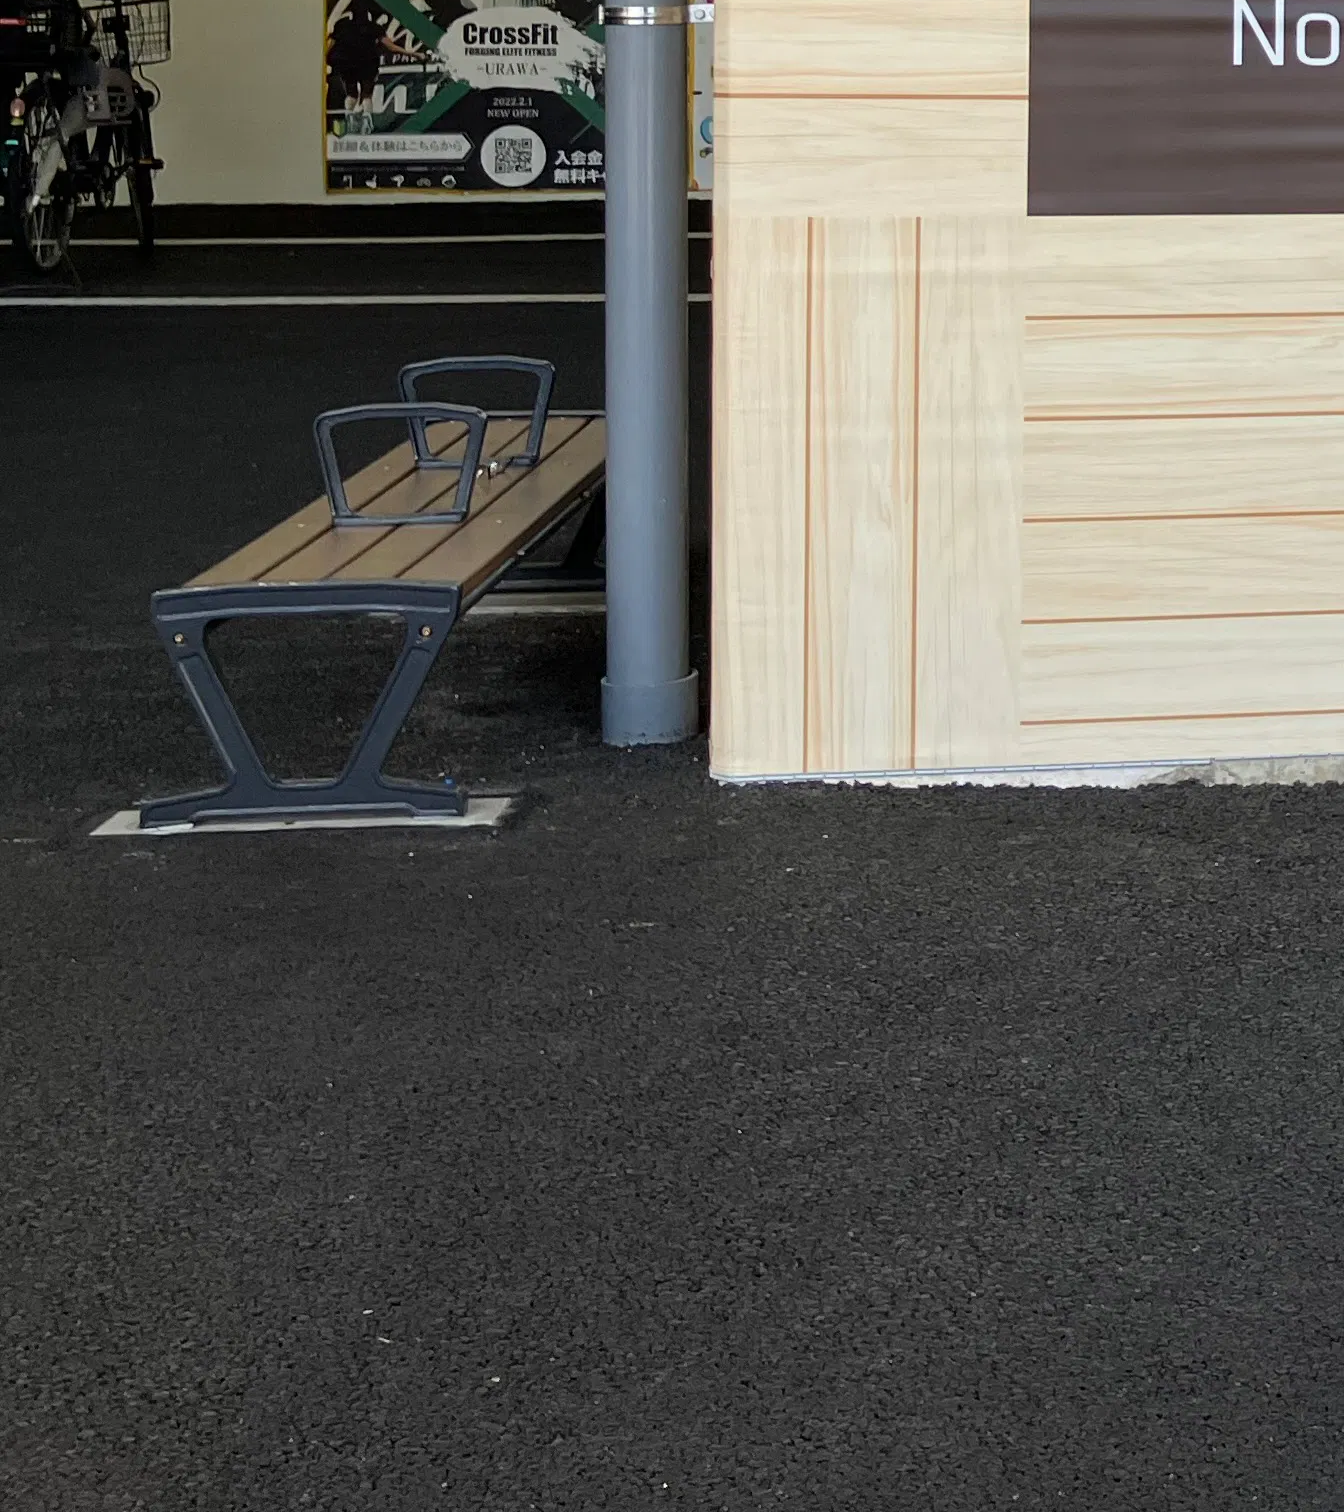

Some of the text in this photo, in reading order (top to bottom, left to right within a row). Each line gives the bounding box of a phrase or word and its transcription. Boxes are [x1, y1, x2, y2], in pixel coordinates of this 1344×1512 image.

[463, 22, 559, 45] CrossFit
[464, 47, 557, 57] FORGING ELITE FITNESS
[492, 97, 533, 107] 2022.2.1
[487, 108, 540, 118] NEW OPEN
[554, 149, 604, 166] 入会金
